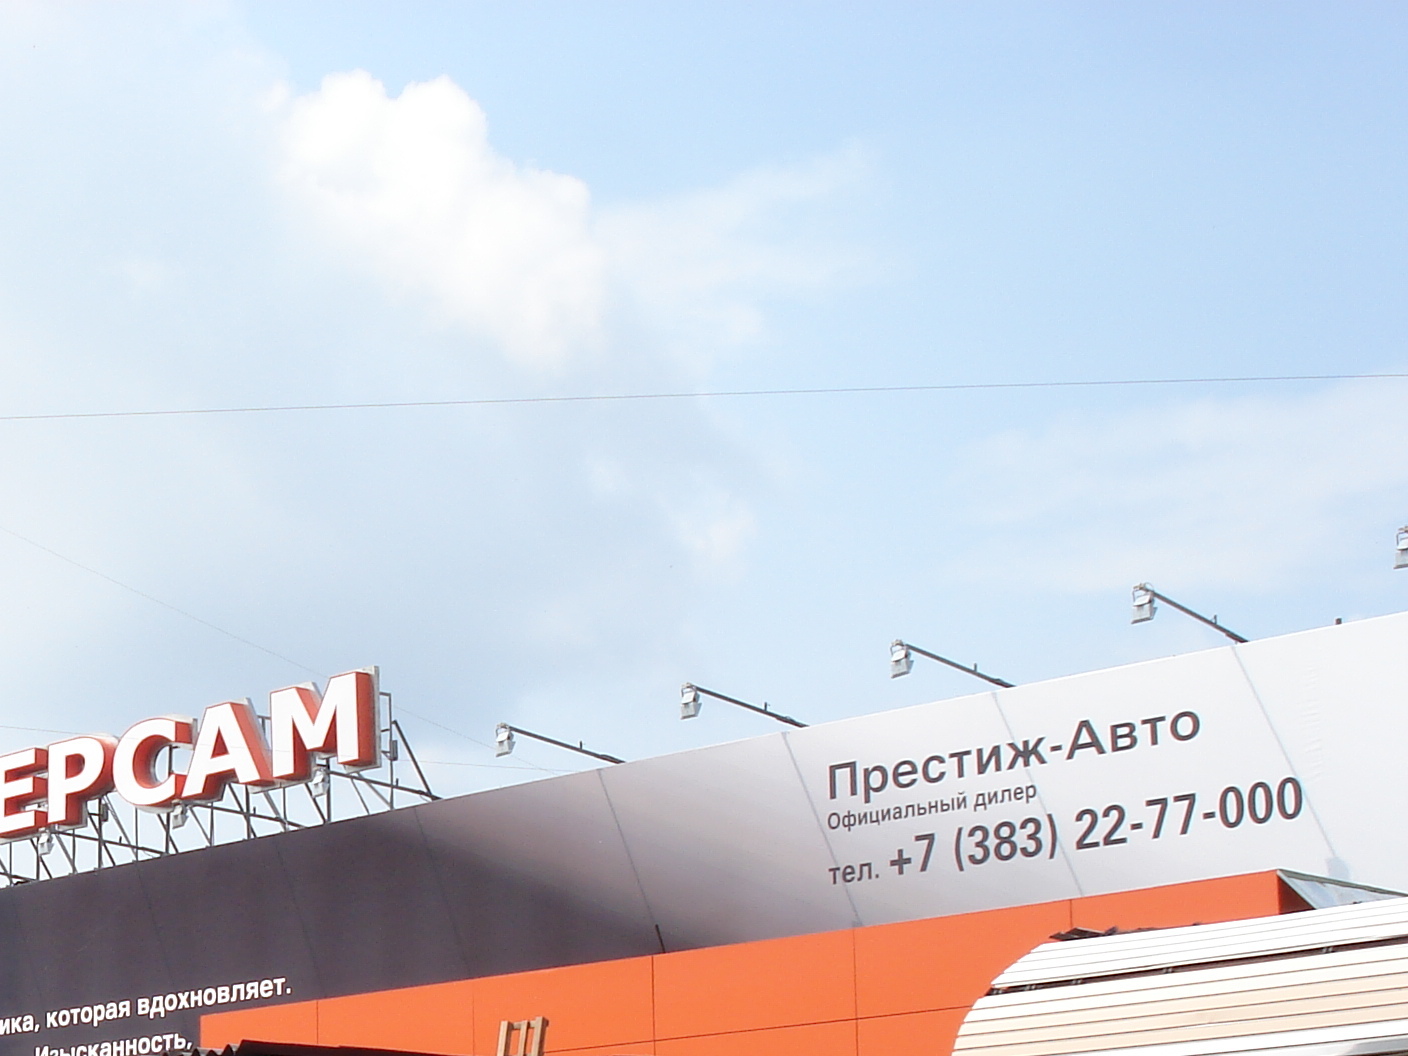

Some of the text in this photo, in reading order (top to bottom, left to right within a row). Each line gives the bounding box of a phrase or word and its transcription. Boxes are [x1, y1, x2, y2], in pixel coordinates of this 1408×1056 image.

[828, 710, 1202, 804] Престиж-Авто
[827, 783, 1038, 832] Официальный дилер
[828, 776, 1304, 886] тел. +7 (383) 22-77-000
[46, 997, 131, 1029] которая
[137, 976, 293, 1021] вдохновляет.
